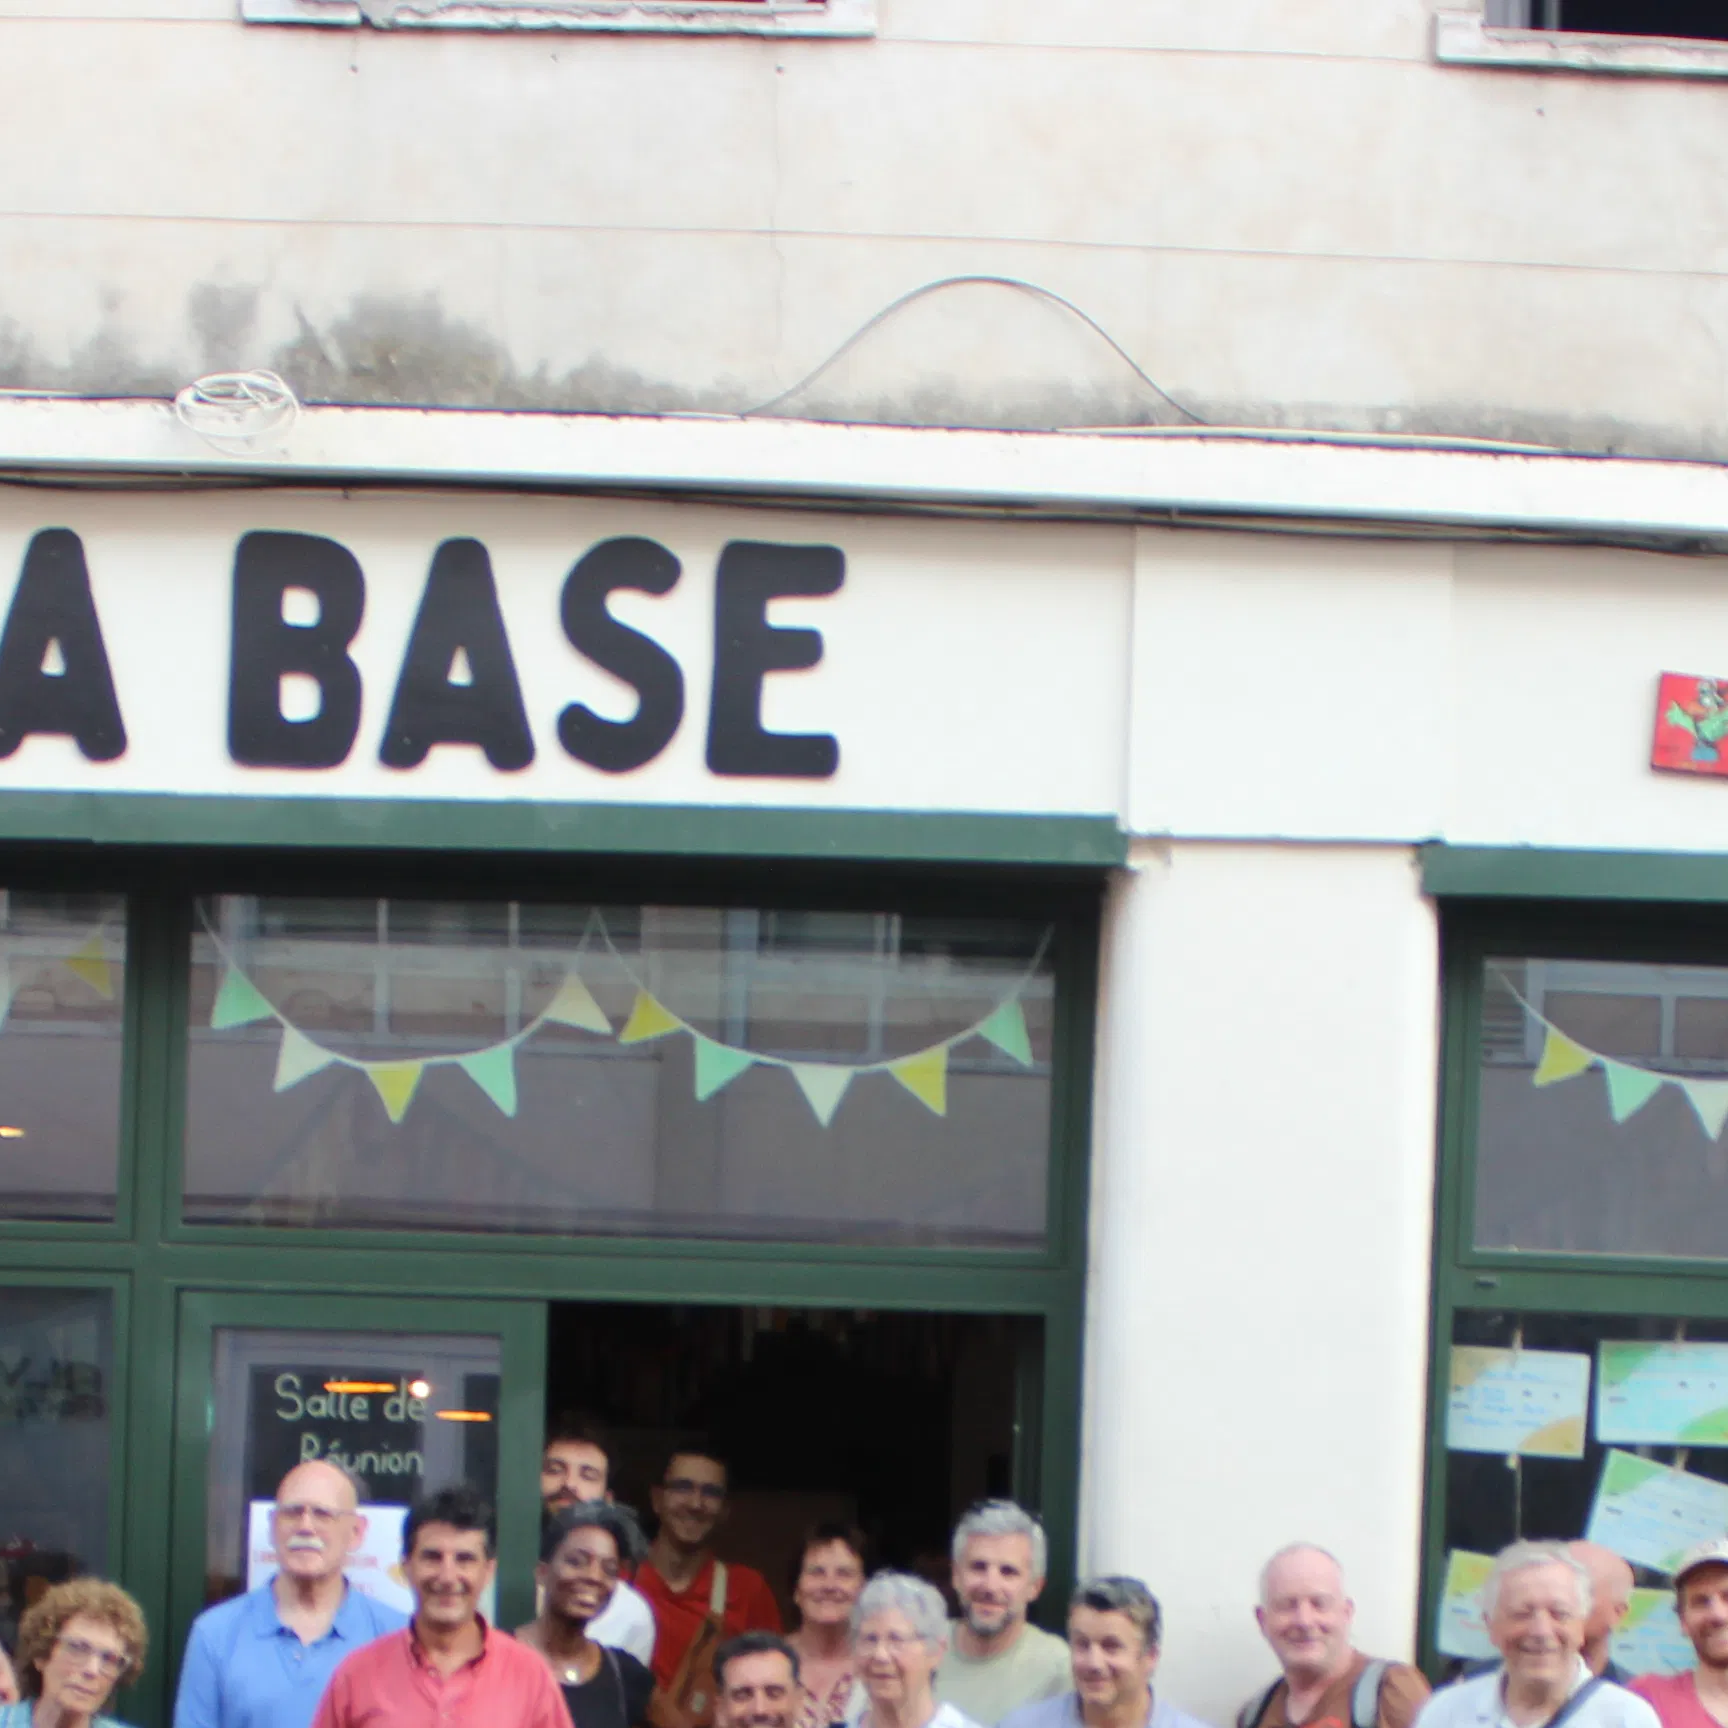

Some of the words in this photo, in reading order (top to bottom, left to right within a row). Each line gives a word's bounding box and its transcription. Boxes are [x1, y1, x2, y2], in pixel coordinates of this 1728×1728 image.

[226, 530, 845, 778] BASE
[275, 1373, 371, 1421] Salle
[383, 1376, 429, 1422] de
